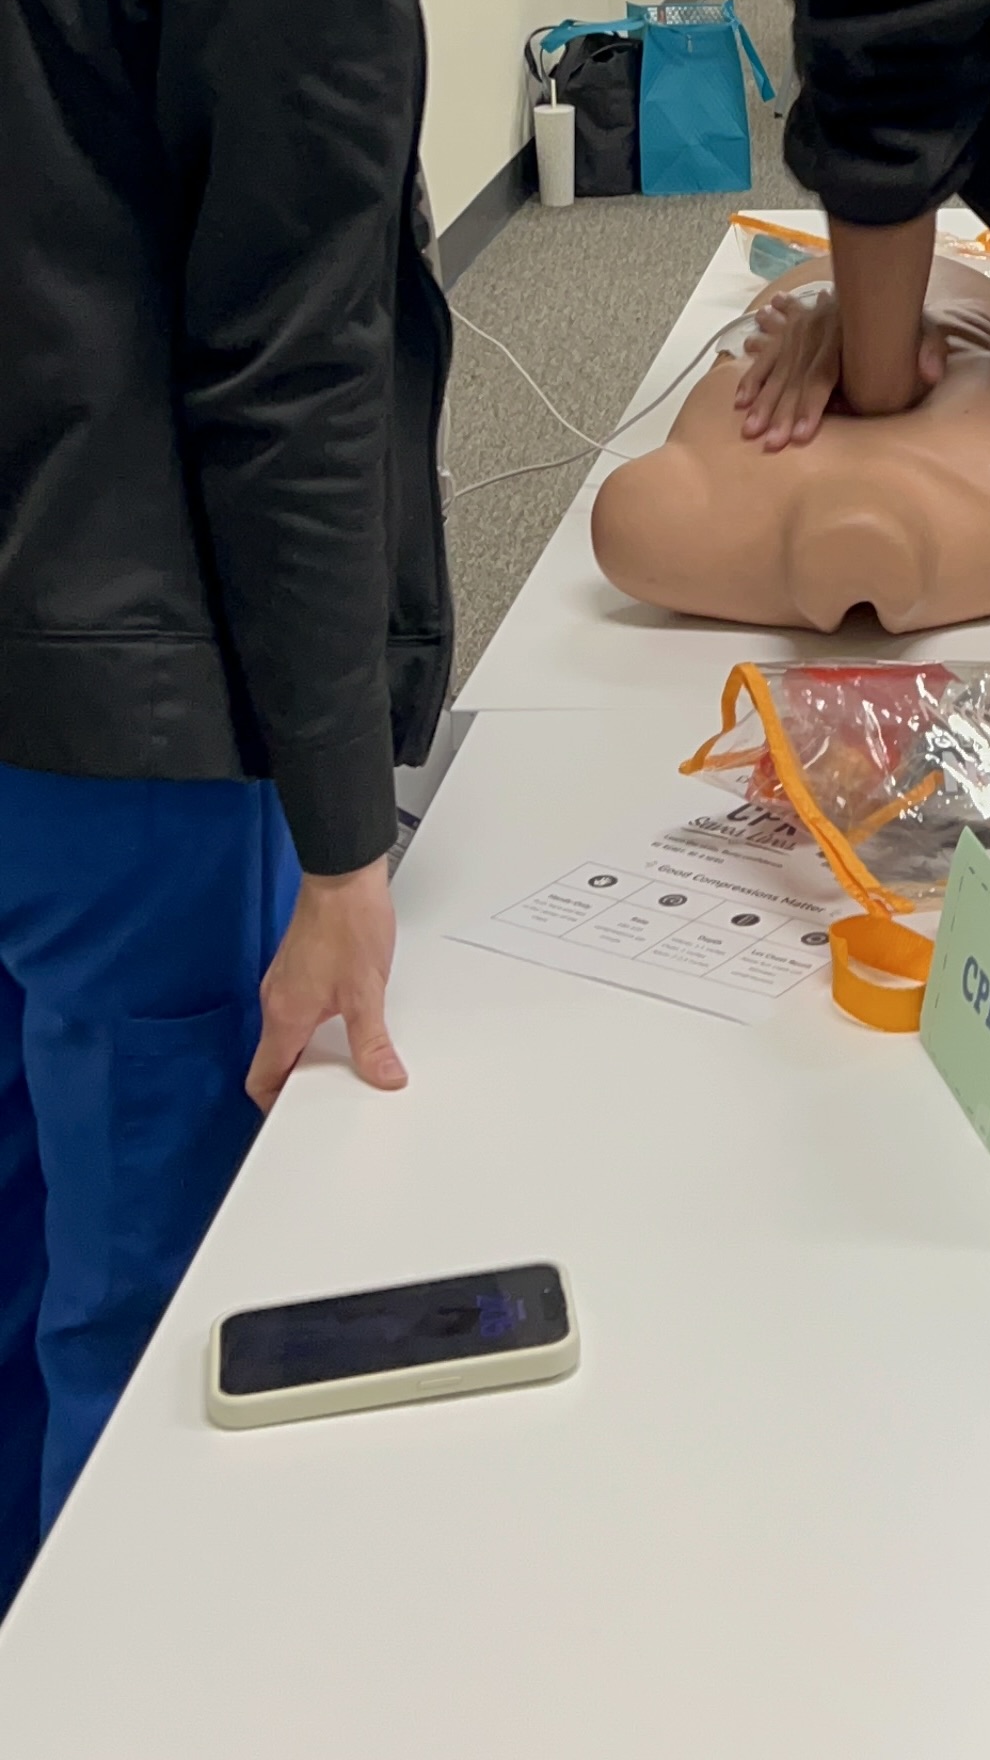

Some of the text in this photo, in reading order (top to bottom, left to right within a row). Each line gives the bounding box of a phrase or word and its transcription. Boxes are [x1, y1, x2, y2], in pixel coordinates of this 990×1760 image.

[657, 863, 828, 914] Good Compressions Matter
